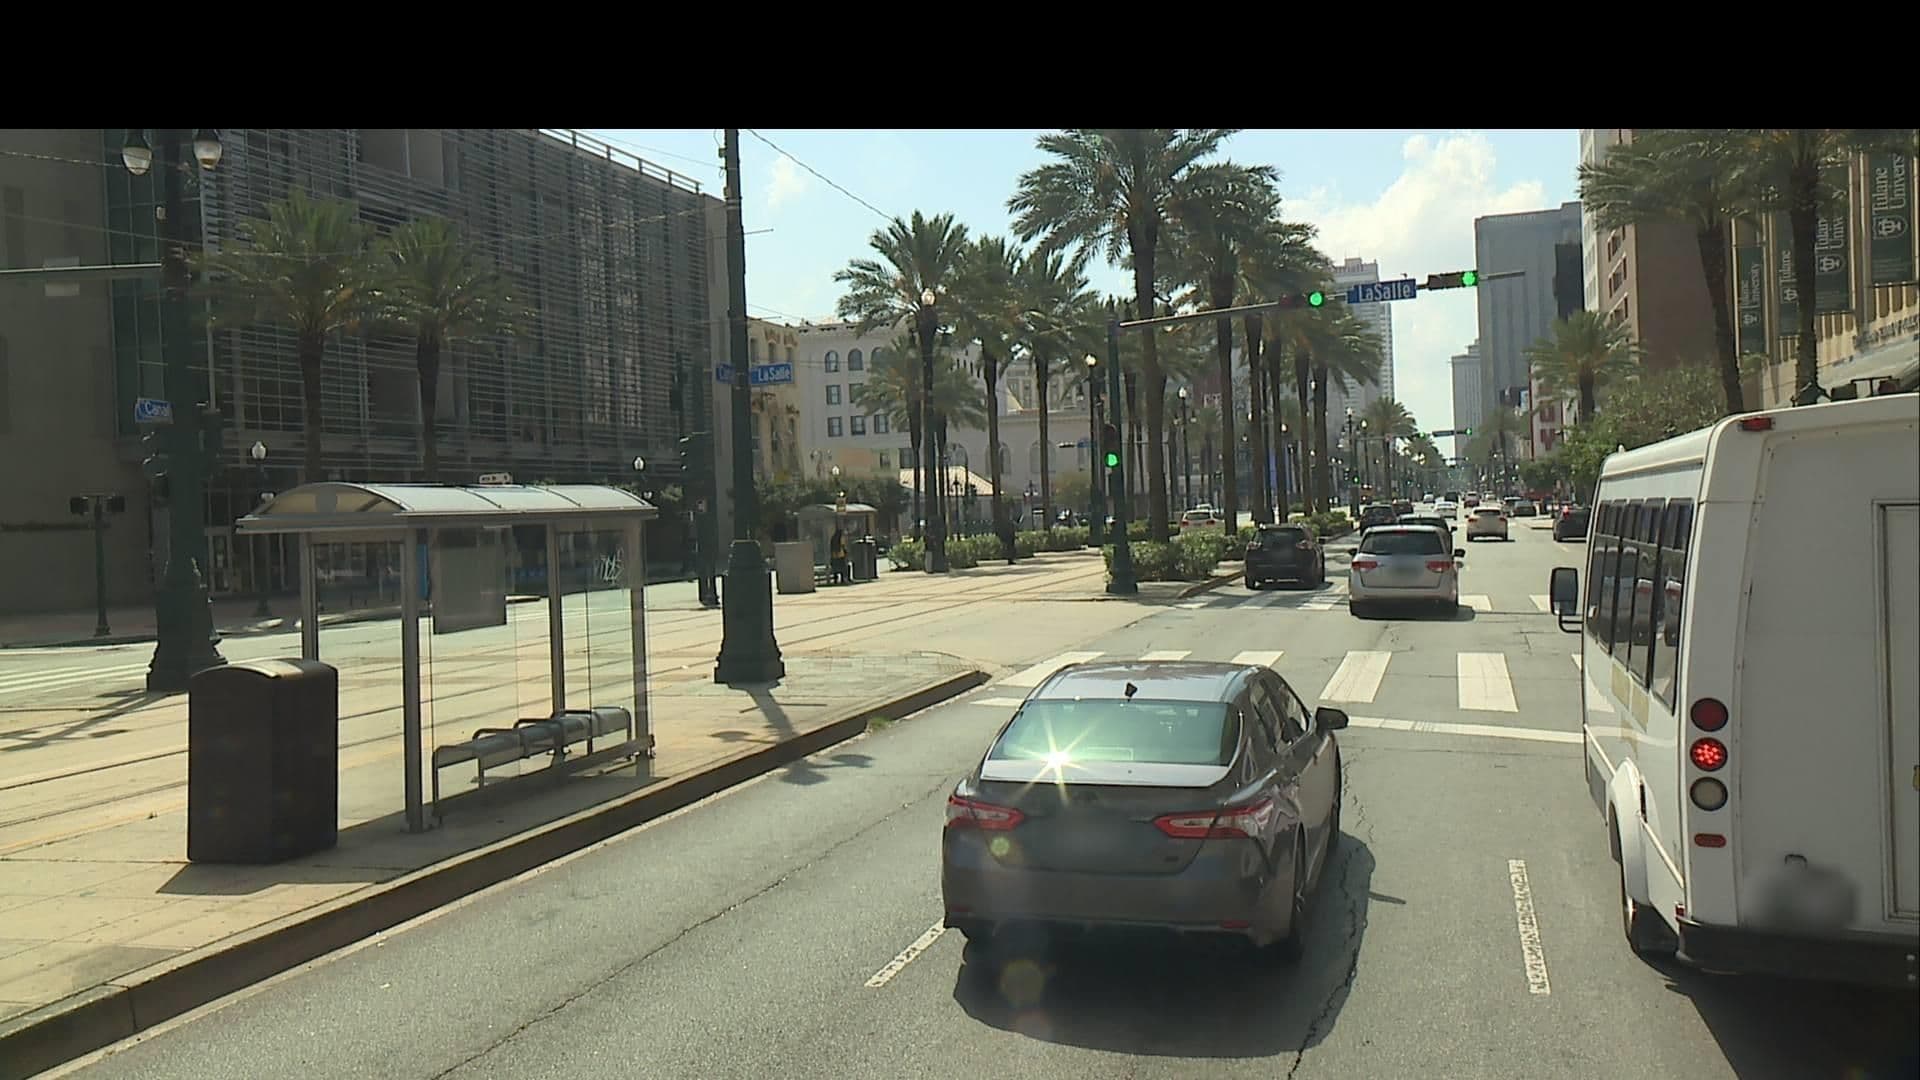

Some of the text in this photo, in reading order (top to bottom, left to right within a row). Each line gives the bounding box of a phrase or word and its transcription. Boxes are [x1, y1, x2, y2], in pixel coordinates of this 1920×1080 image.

[1872, 167, 1888, 215] Tulane
[1888, 153, 1906, 210] Univers
[1814, 216, 1829, 254] Tulan
[1778, 250, 1792, 286] Tulane
[1359, 282, 1411, 301] LaSalle
[758, 364, 791, 382] LaSalle
